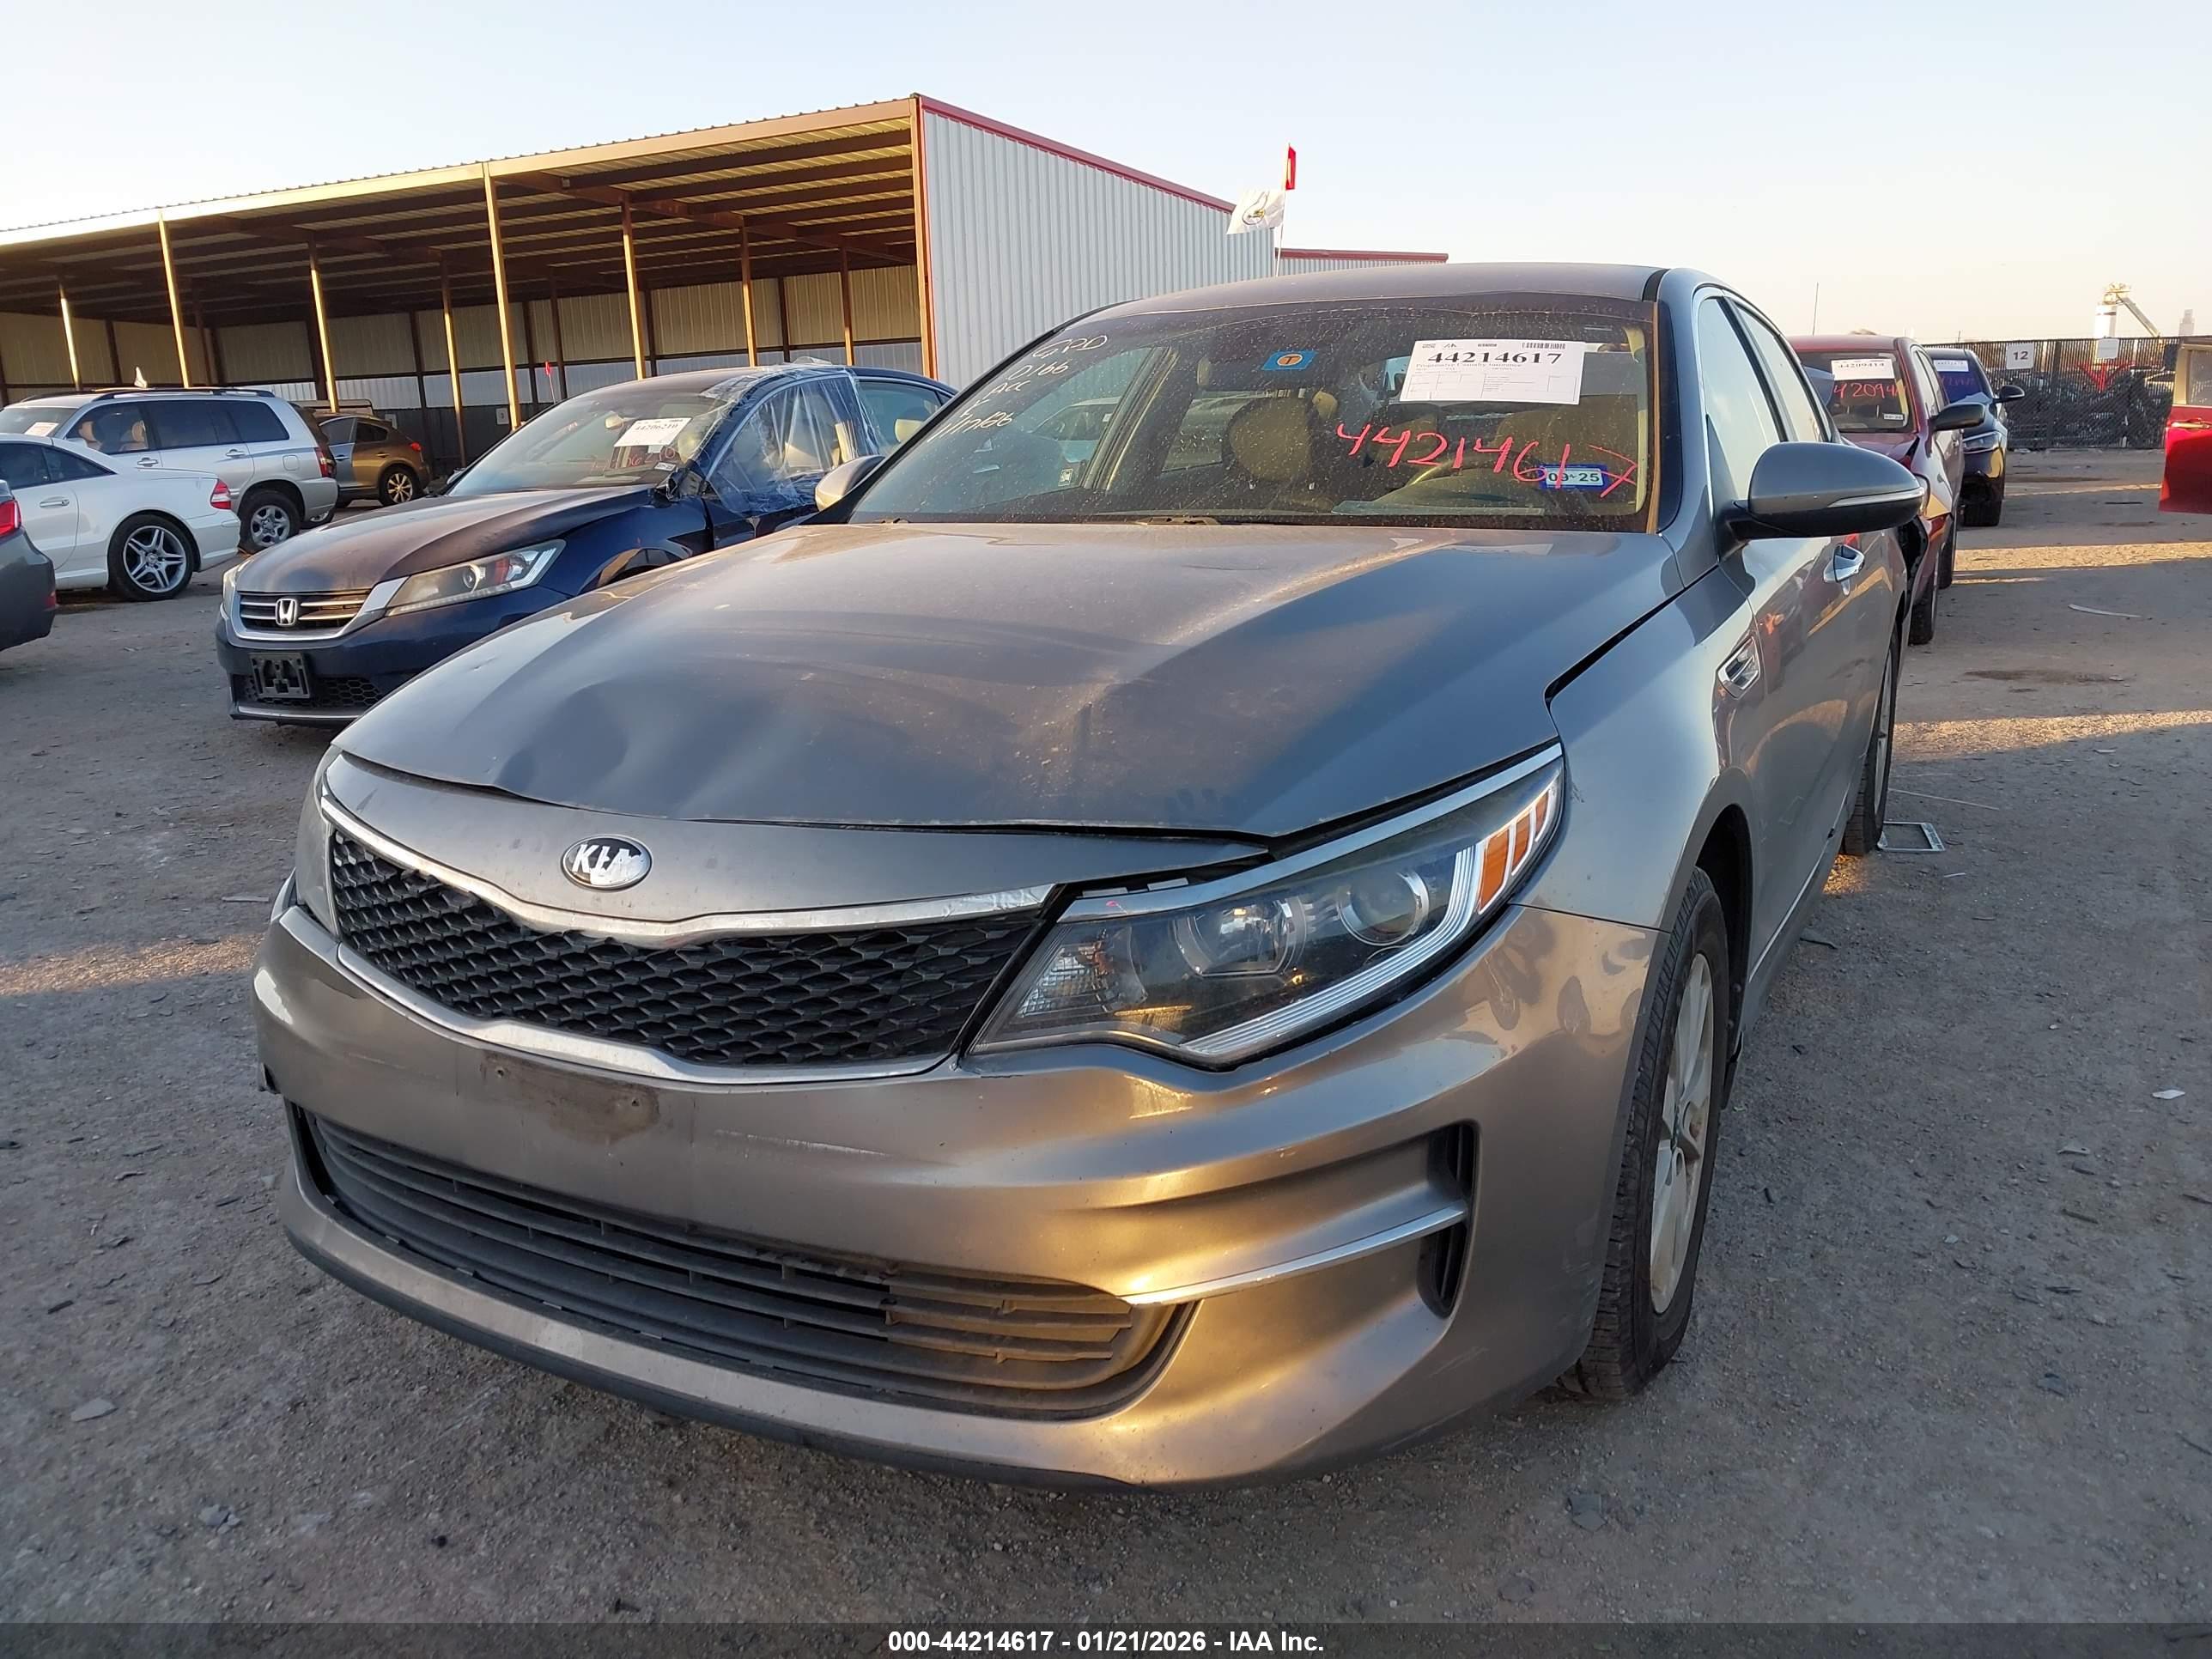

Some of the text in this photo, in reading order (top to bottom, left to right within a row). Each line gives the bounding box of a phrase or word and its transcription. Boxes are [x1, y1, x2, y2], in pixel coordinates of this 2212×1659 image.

[1428, 351, 1563, 364] 44214617
[2013, 350, 2028, 361] 12
[1336, 422, 1638, 498] 44214617
